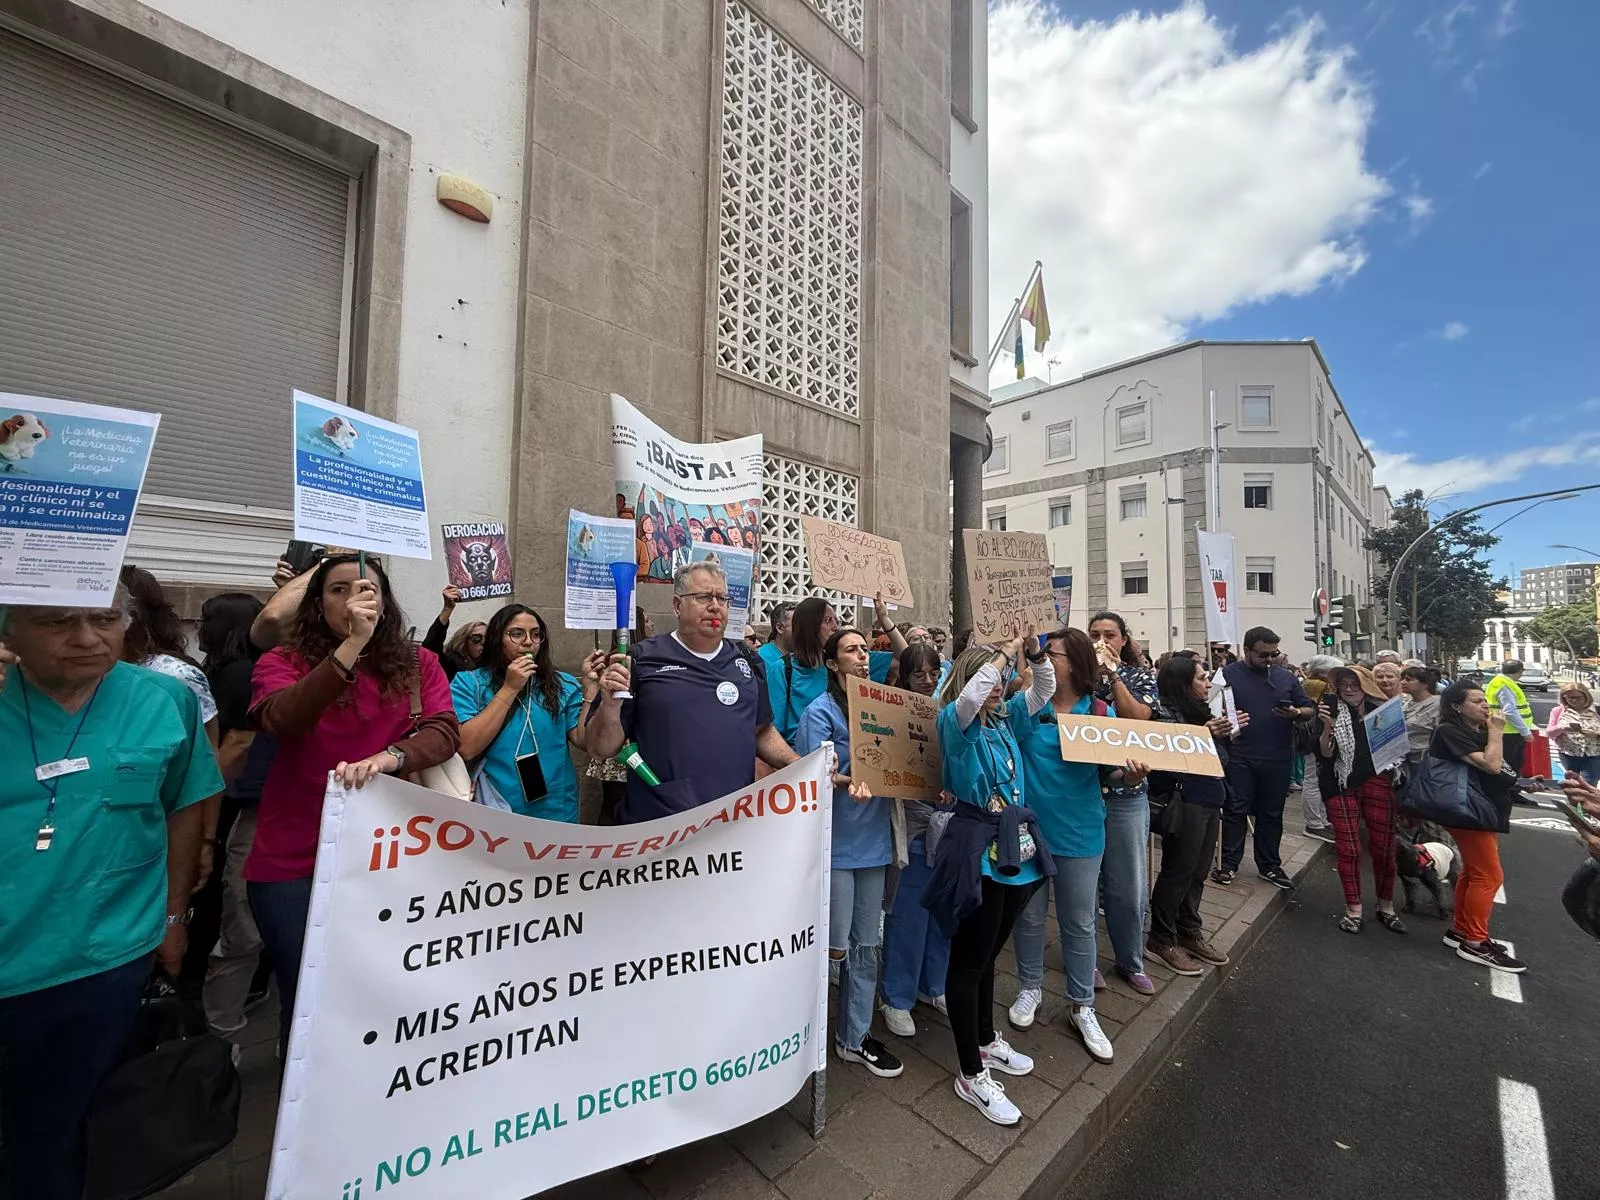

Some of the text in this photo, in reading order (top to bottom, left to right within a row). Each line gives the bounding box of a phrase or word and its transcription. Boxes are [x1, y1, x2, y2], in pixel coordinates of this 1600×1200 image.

[61, 436, 136, 454] Veterinaria
[309, 455, 321, 463] La
[324, 459, 396, 483] profesionalidad
[647, 440, 736, 481] ¡BASTA!
[0, 480, 120, 499] fesionalidad y el
[301, 470, 349, 485] cuestiona
[351, 480, 360, 488] ni
[374, 486, 422, 502] criminaliza
[318, 465, 353, 479] criterio
[355, 475, 384, 487] clínico
[11, 504, 24, 513] ni
[28, 506, 45, 514] se
[49, 507, 125, 521] criminaliza
[21, 493, 67, 505] clínico
[71, 498, 84, 507] ni
[21, 520, 75, 529] Medicamentos
[77, 525, 122, 533] Veterinarios!
[443, 522, 505, 538] DEROGACION
[976, 533, 989, 557] NO
[992, 538, 1002, 556] AL
[470, 583, 511, 598] 666/2023
[1000, 607, 1045, 637] BASTA YA
[1062, 724, 1218, 756] VOCACIÓN
[369, 781, 817, 871] ¡¡SOY VETERINARIO!!
[406, 851, 743, 923] 5 AÑOS DE CARRERA ME
[403, 912, 583, 972] CERTIFICAN
[395, 925, 815, 1043] MIS AÑOS DE EXPERIENCIA ME
[386, 1017, 578, 1099] ACREDITAN
[375, 1146, 431, 1192] NO
[441, 1129, 483, 1167] AL
[494, 1102, 568, 1148] REAL
[577, 1067, 697, 1121] DECRETO
[705, 1032, 800, 1085] 666/2023
